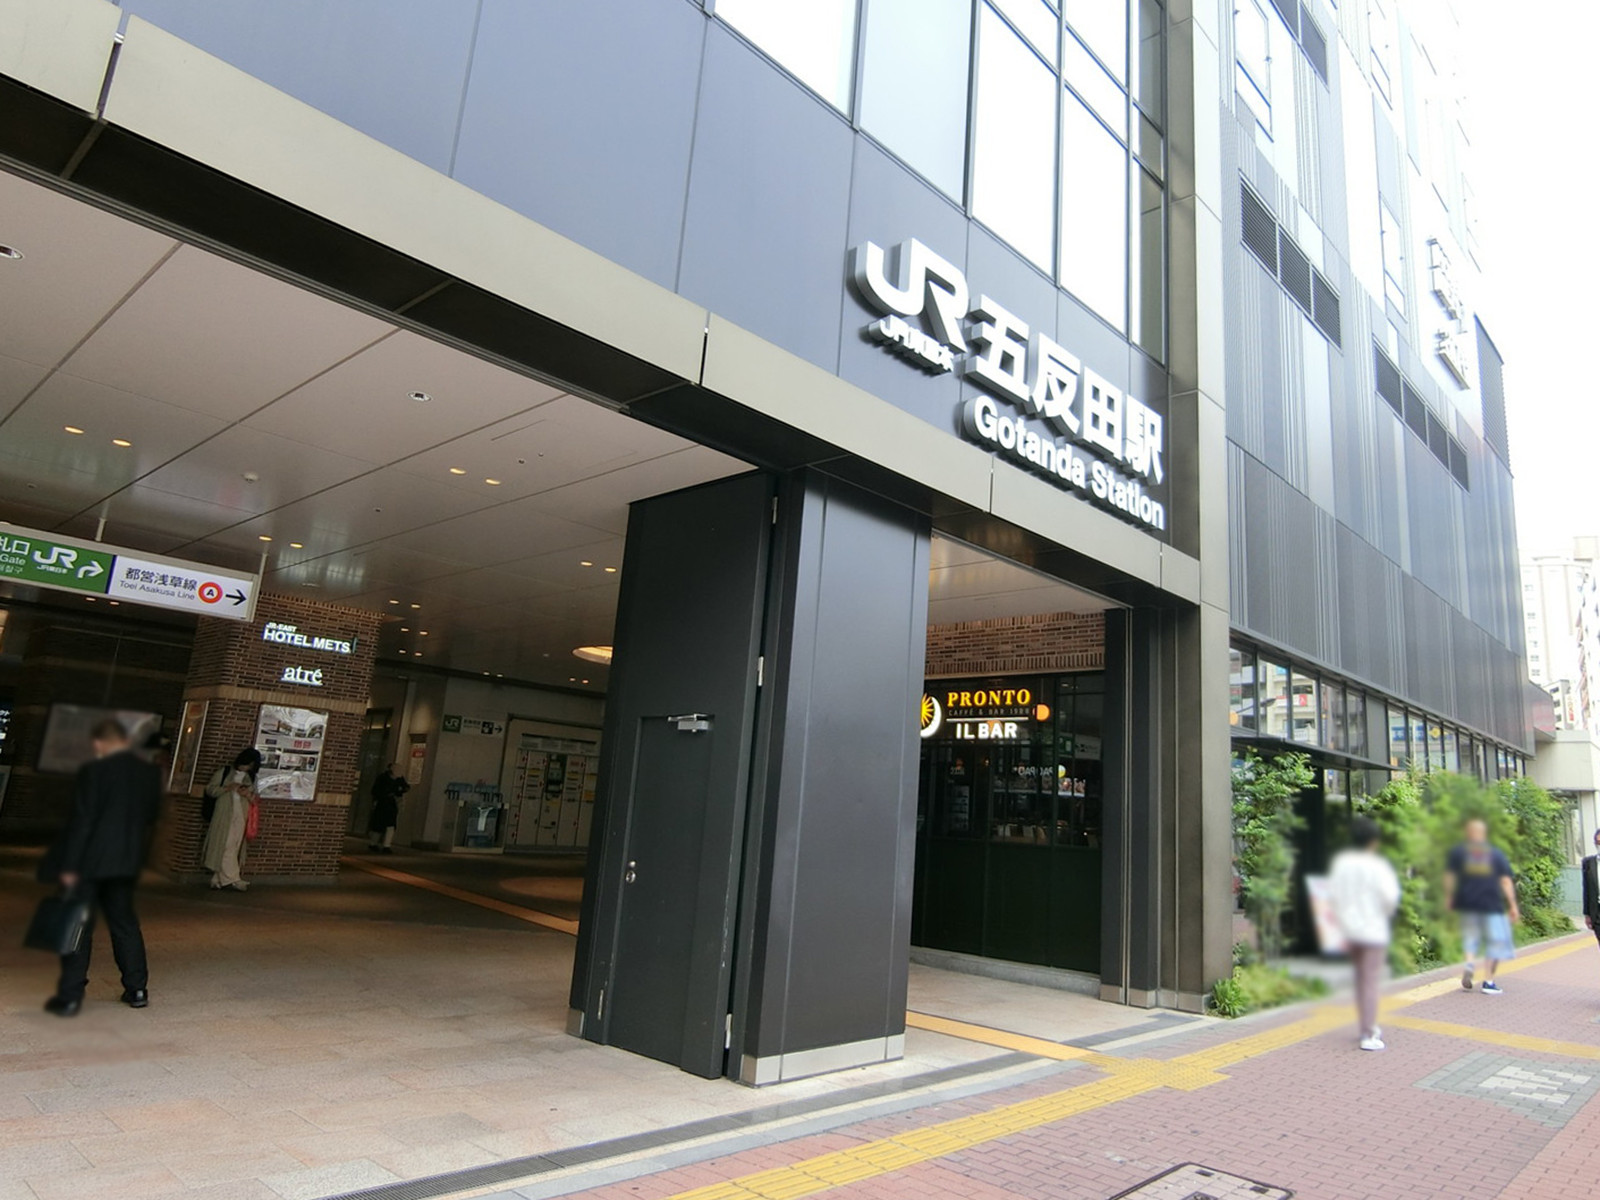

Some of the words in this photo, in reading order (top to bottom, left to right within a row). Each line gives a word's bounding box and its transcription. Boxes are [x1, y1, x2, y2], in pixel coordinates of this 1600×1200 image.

[974, 293, 1164, 485] 五反田駅
[974, 394, 1086, 489] Gotanda
[1090, 460, 1165, 531] Station
[0, 553, 26, 566] Gate
[33, 547, 78, 569] JR
[119, 580, 137, 590] Toei
[139, 584, 176, 597] Asakusa
[177, 591, 195, 600] Line
[125, 567, 198, 592] 都営浅草線
[263, 628, 312, 647] HOTEL
[313, 637, 351, 654] METS
[281, 666, 323, 685] atré
[947, 689, 1031, 707] PRONTO
[956, 723, 976, 739] IL
[978, 722, 1018, 739] BAR
